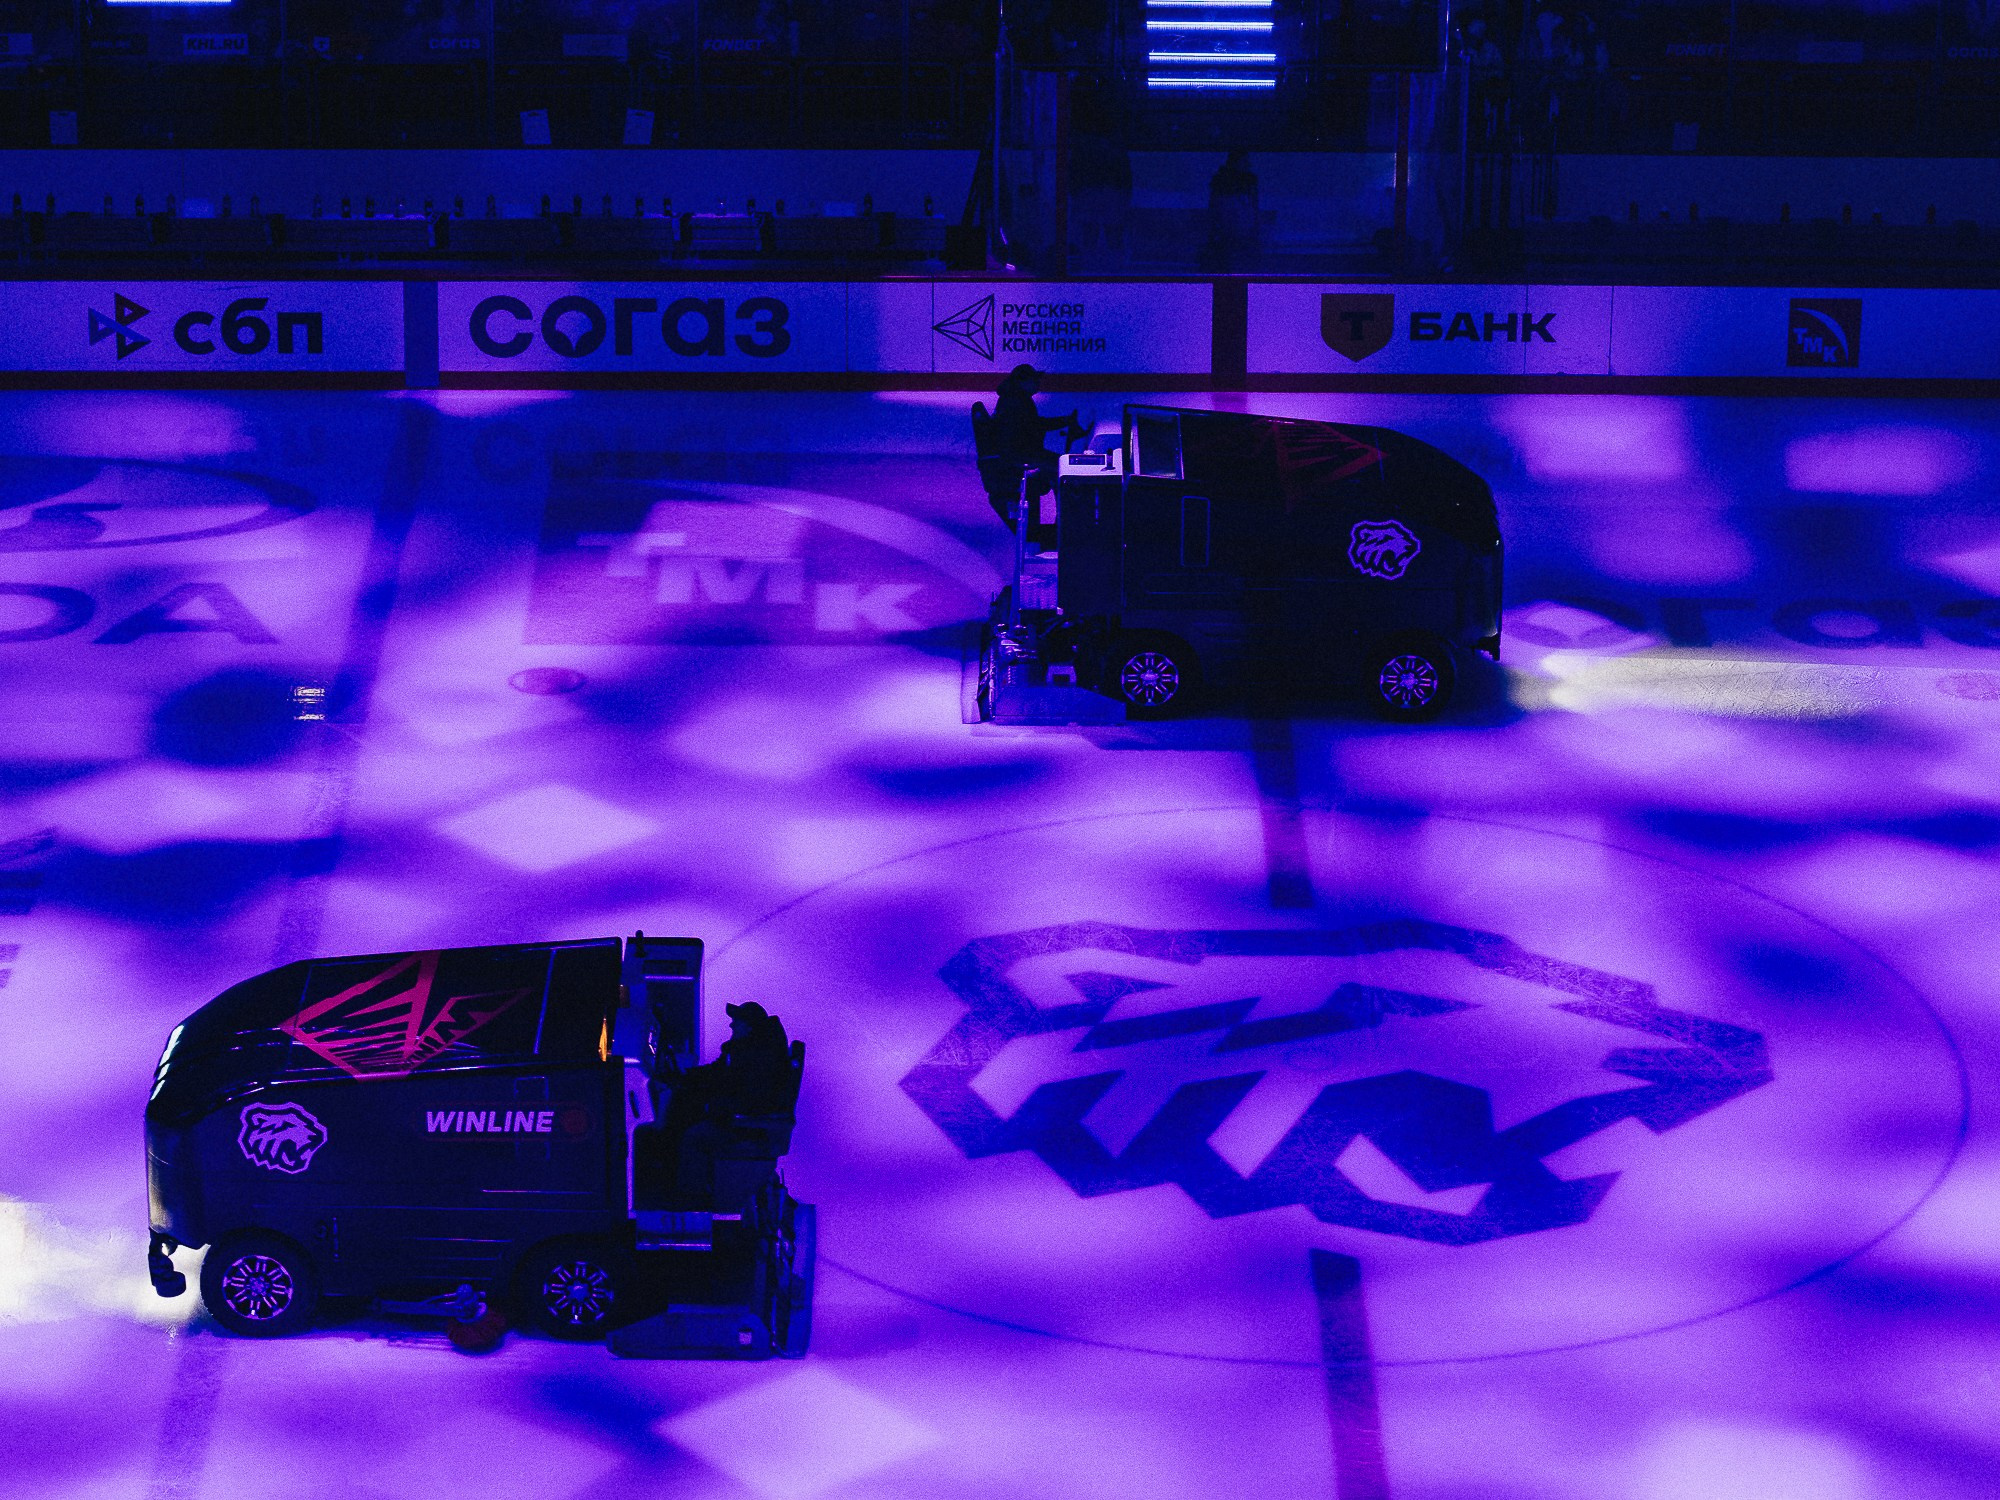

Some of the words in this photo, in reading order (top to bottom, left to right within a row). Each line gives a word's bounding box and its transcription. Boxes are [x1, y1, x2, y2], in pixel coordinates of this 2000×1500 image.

[1002, 303, 1085, 318] РУССКАЯ
[1002, 321, 1081, 335] МЕДНАЯ
[1409, 311, 1557, 343] БАНК
[1002, 338, 1106, 353] КОМПАНИЯ
[425, 1110, 556, 1133] WINLINE
